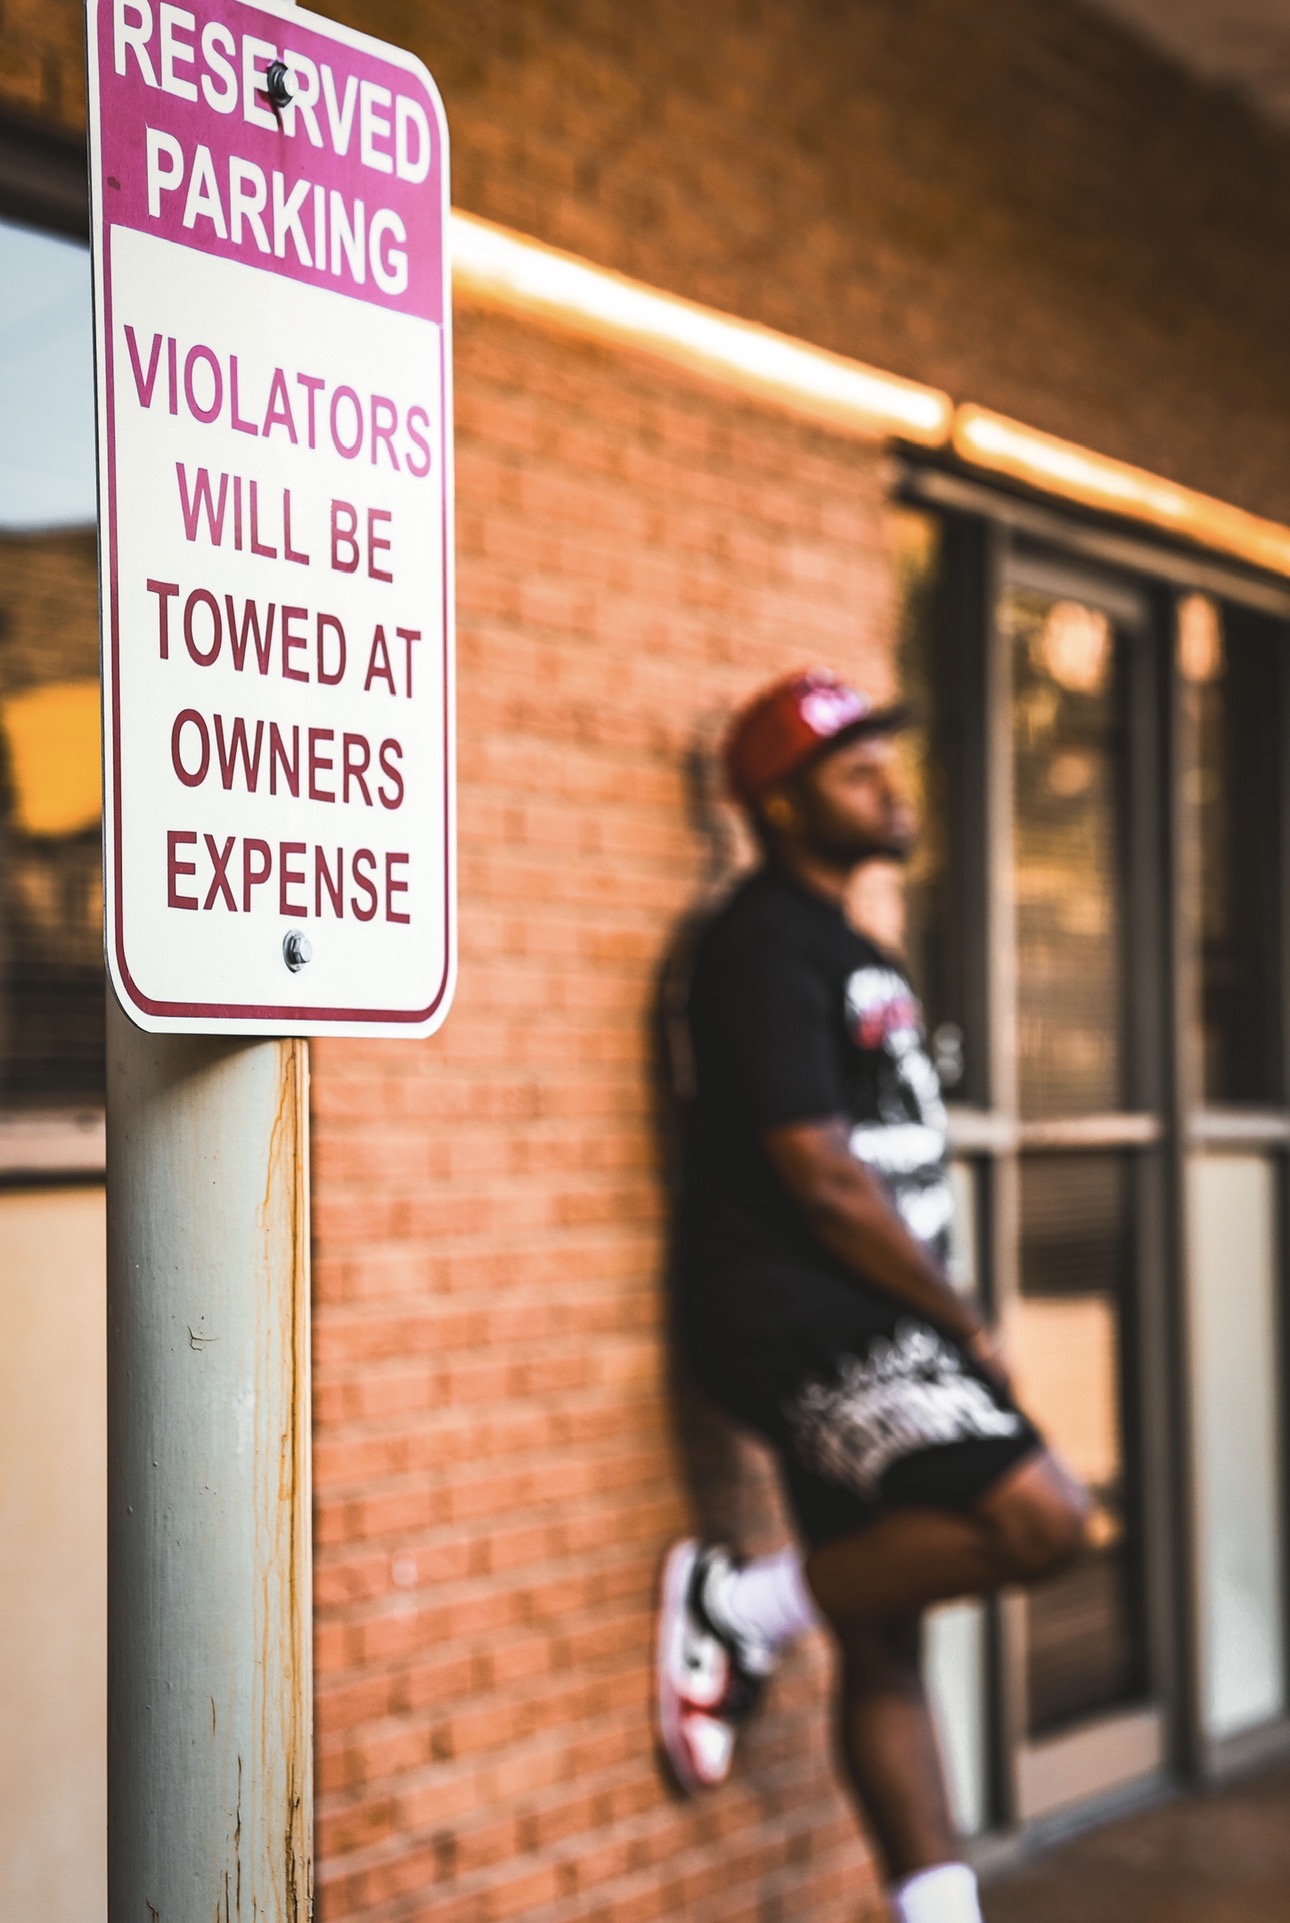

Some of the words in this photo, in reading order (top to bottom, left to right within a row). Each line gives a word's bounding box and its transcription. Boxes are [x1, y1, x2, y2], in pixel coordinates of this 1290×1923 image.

[113, 0, 431, 184] RESERVED
[146, 125, 408, 296] PARKING
[123, 324, 431, 478] VIOLATORS
[175, 462, 310, 566] WILL
[330, 499, 393, 584] BE
[146, 578, 347, 685] TOWED
[363, 624, 421, 699] AT
[171, 708, 404, 810] OWNERS
[167, 830, 411, 924] EXPENSE
